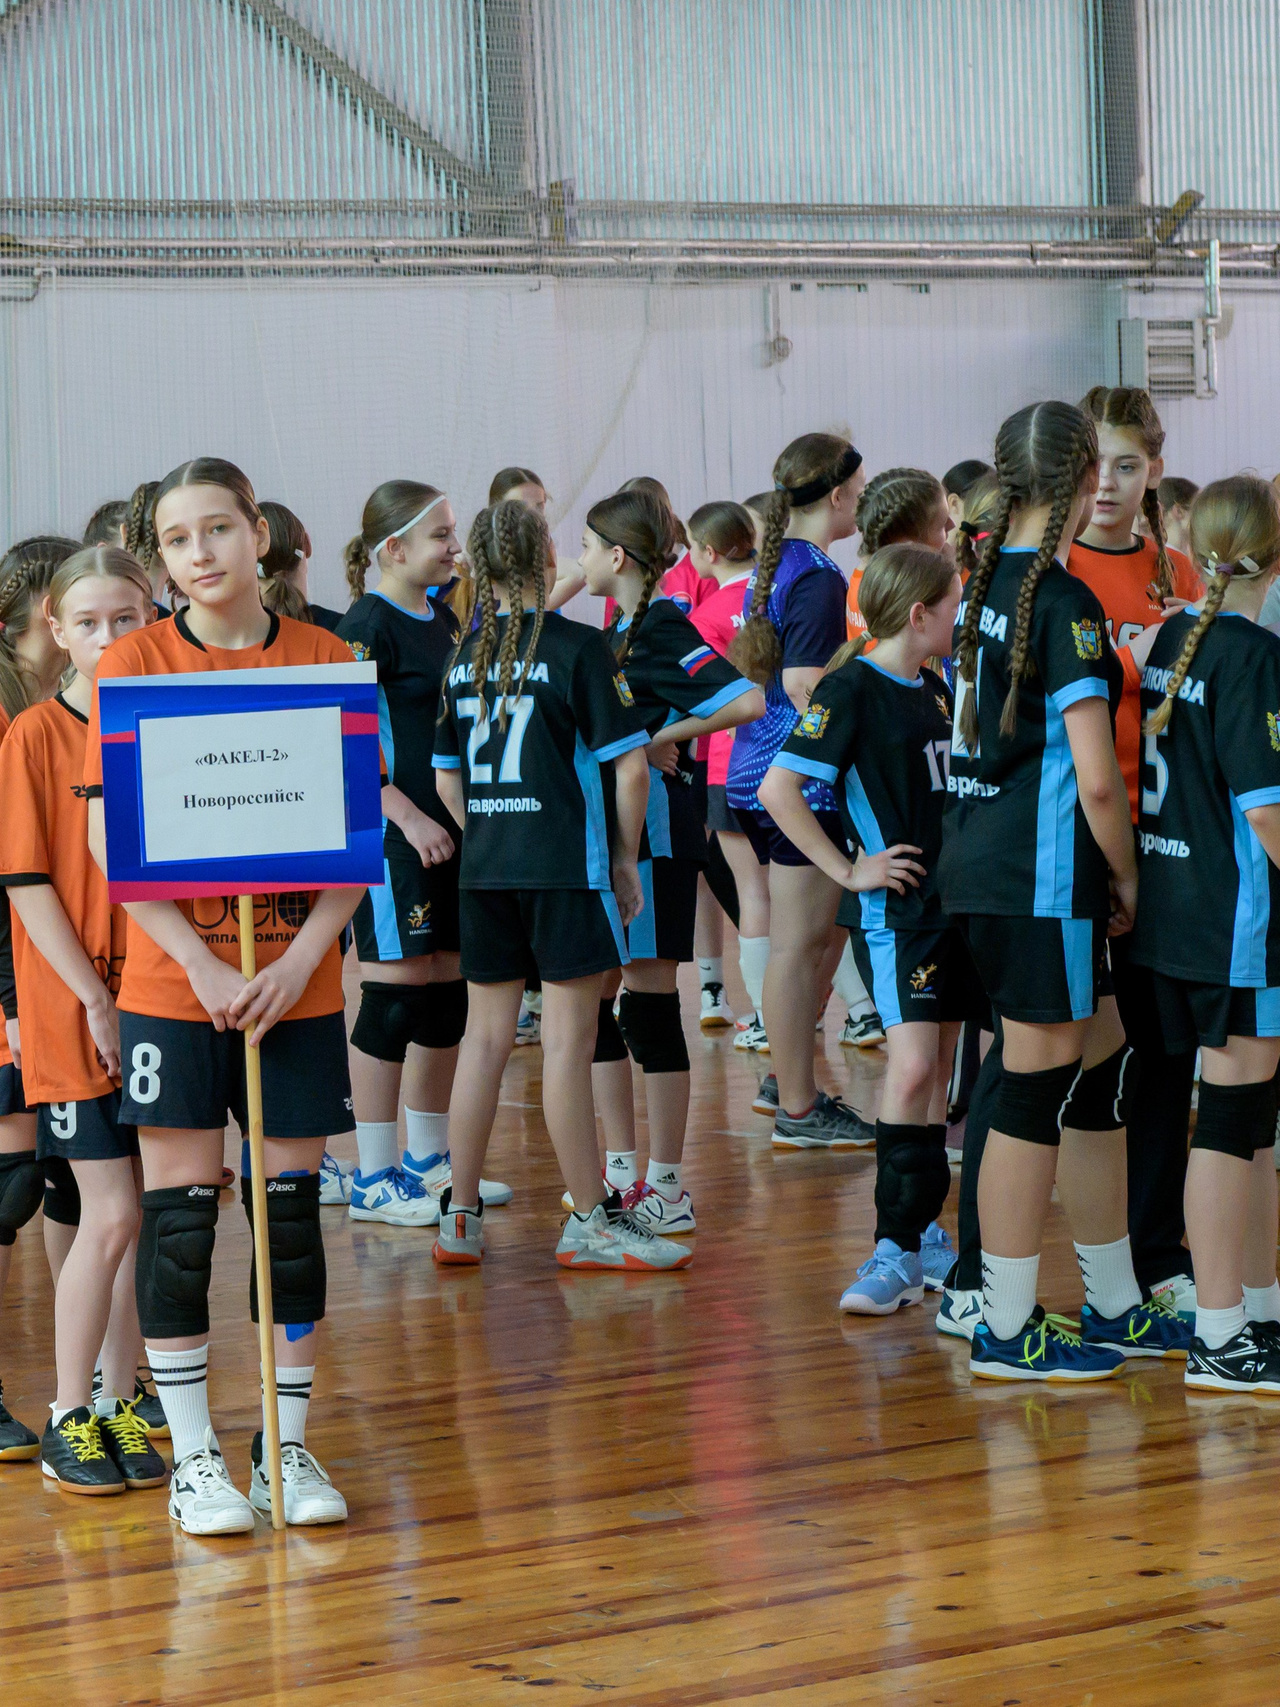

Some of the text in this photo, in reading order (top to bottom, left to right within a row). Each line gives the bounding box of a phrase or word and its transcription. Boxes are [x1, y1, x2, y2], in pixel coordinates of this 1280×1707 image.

[456, 694, 535, 784] 27
[195, 748, 289, 766] «ФАКЕЛ-2»
[183, 789, 305, 810] Новороссийск
[468, 797, 542, 817] таврополь
[129, 1042, 162, 1104] 8
[50, 1101, 77, 1139] 9
[199, 1188, 214, 1196] asics
[276, 1183, 296, 1192] asics
